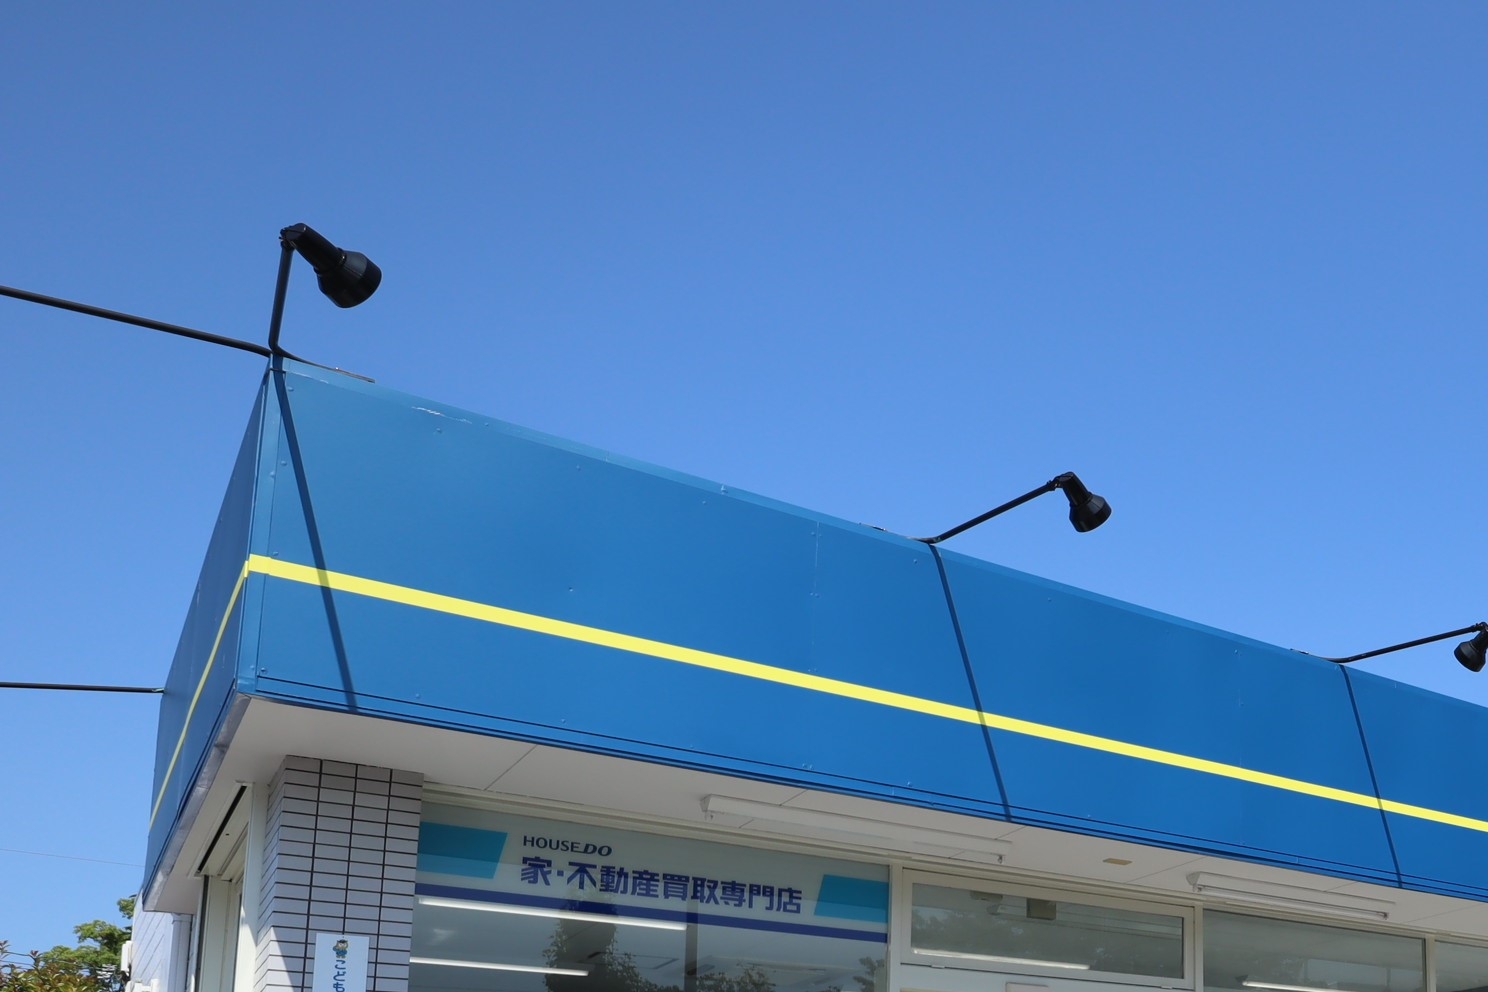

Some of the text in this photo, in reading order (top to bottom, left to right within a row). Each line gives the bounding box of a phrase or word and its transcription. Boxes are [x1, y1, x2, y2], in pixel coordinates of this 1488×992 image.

[520, 856, 803, 914] 家・不動産買取専門店
[333, 959, 347, 992] こども
